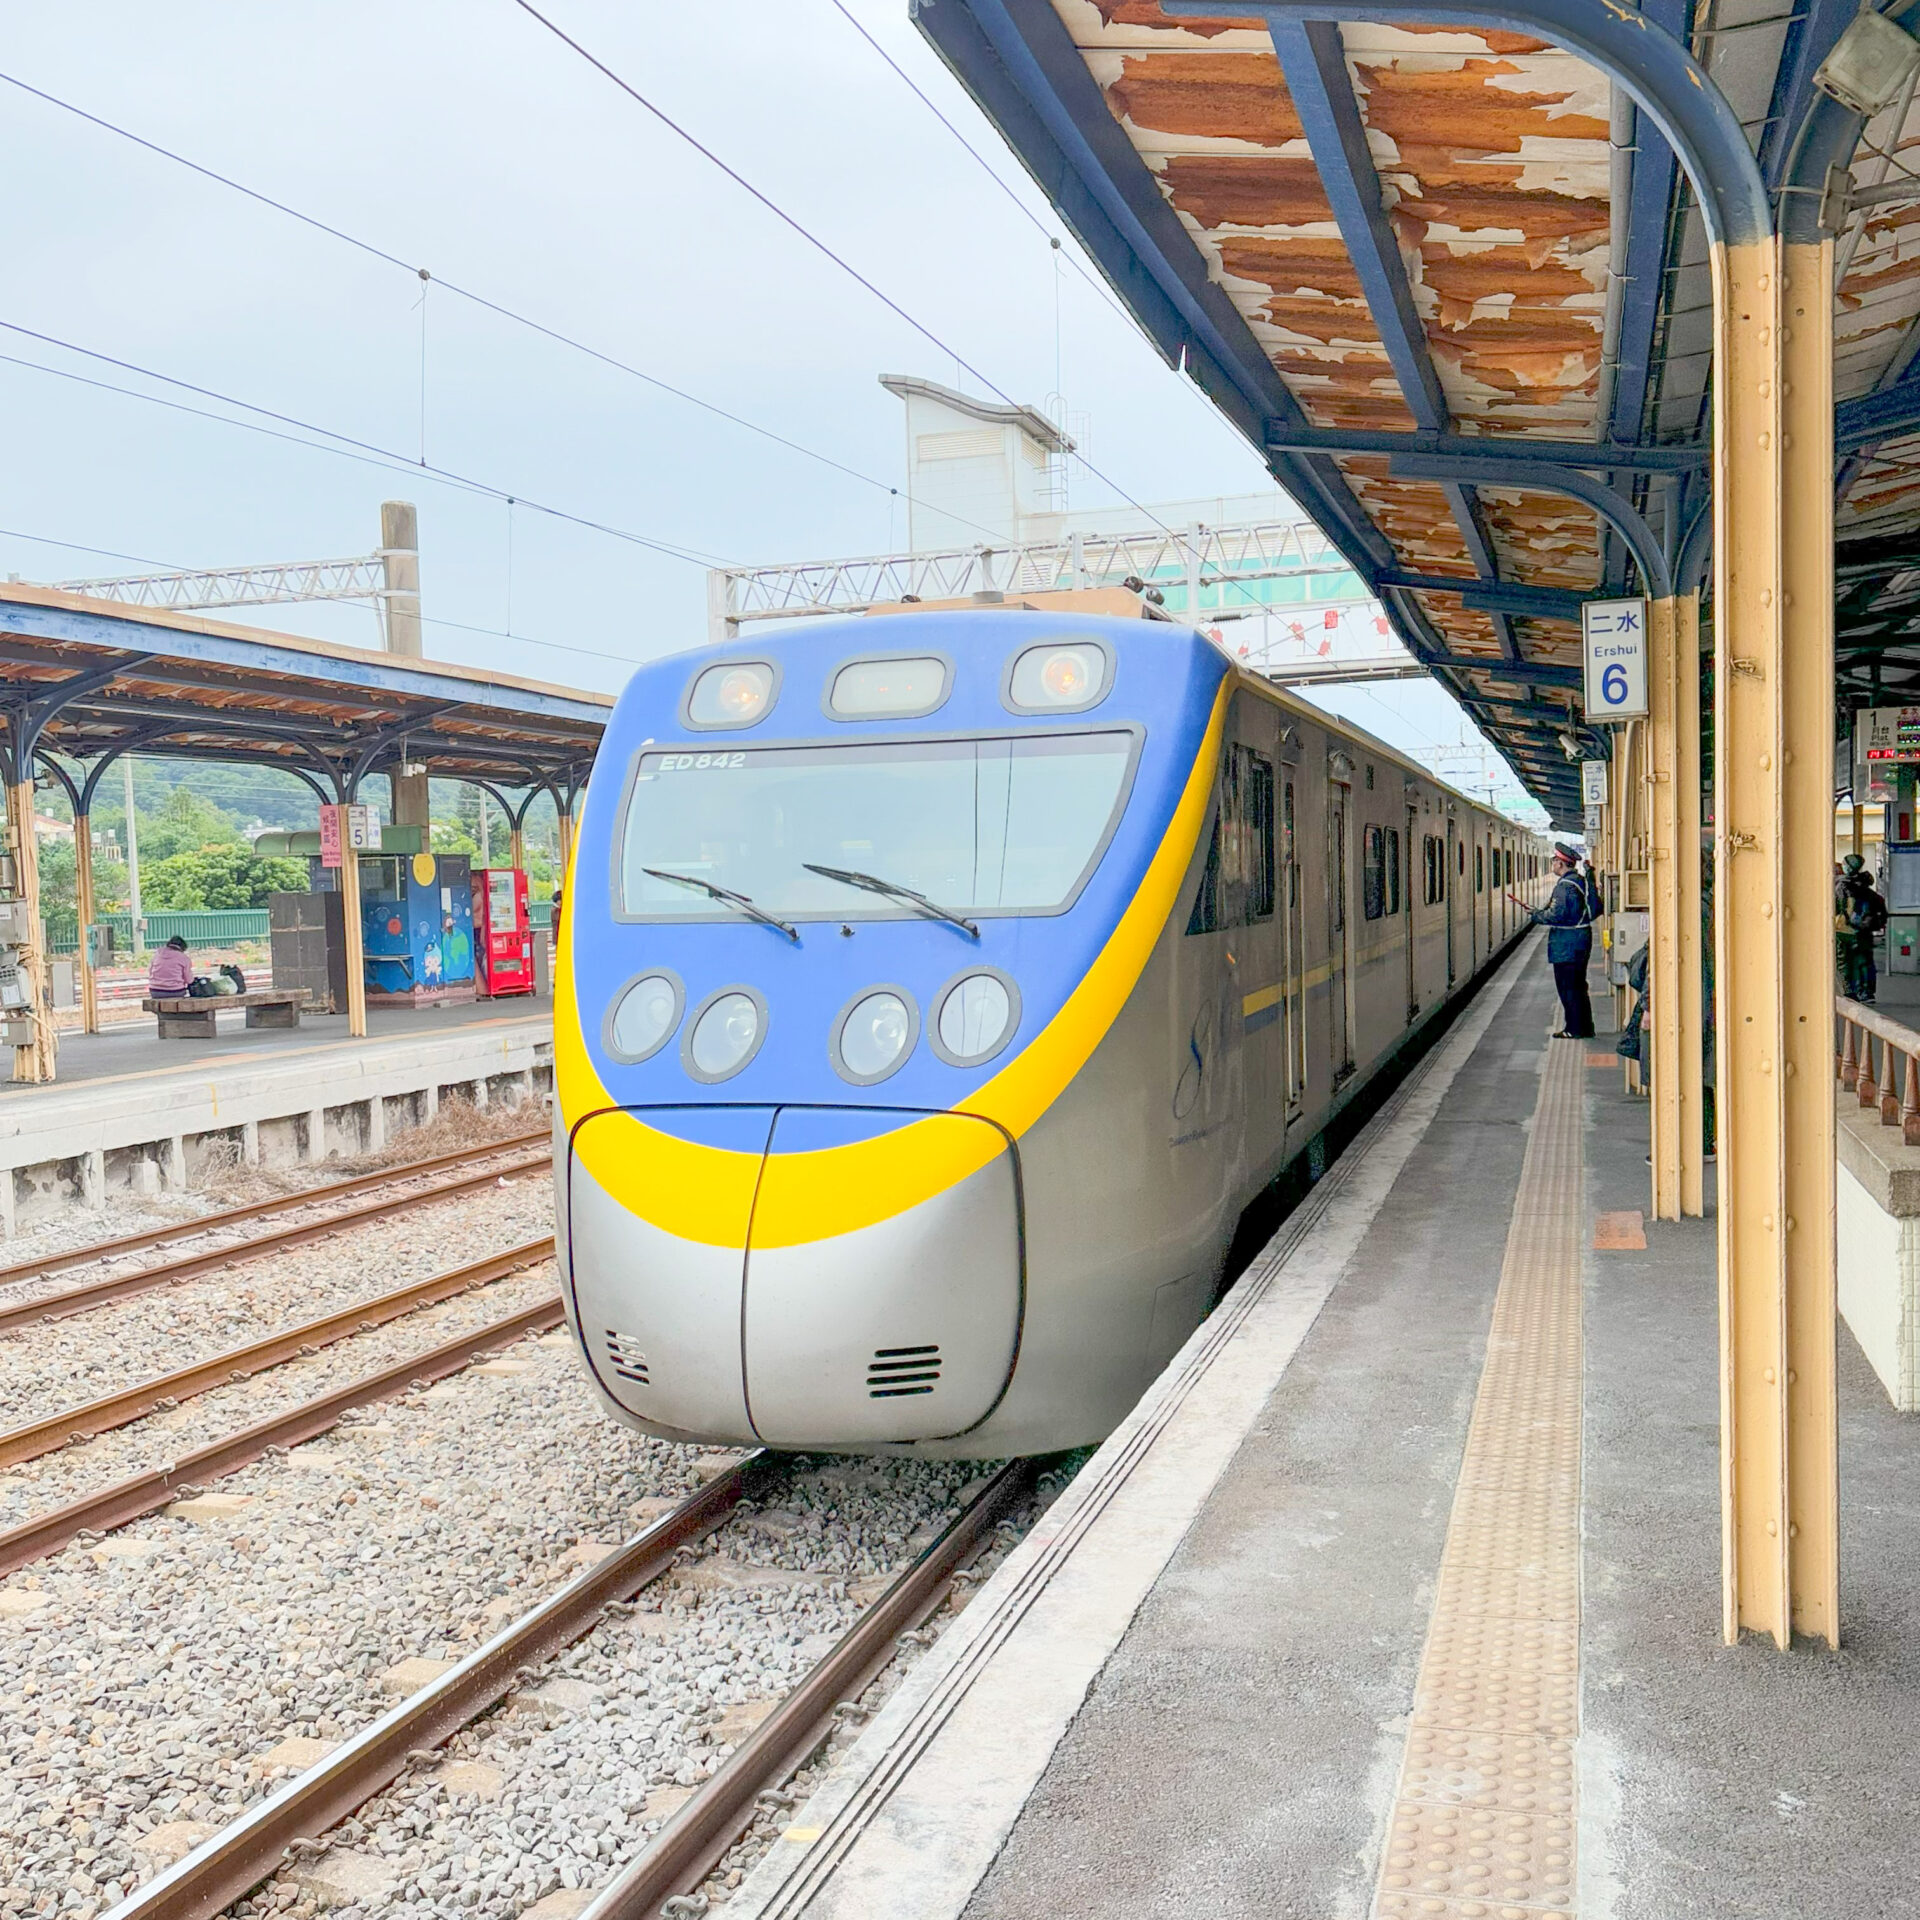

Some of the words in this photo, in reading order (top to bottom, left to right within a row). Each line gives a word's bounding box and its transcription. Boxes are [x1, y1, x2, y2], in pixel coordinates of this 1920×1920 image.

[1590, 611, 1639, 633] 二水
[1594, 644, 1637, 658] Ershui
[1602, 664, 1628, 705] 6
[1870, 711, 1876, 726] 1
[1585, 765, 1604, 774] 二水
[1591, 785, 1600, 800] 5
[350, 810, 366, 818] 二水
[1589, 818, 1596, 827] 4
[355, 829, 362, 845] 5
